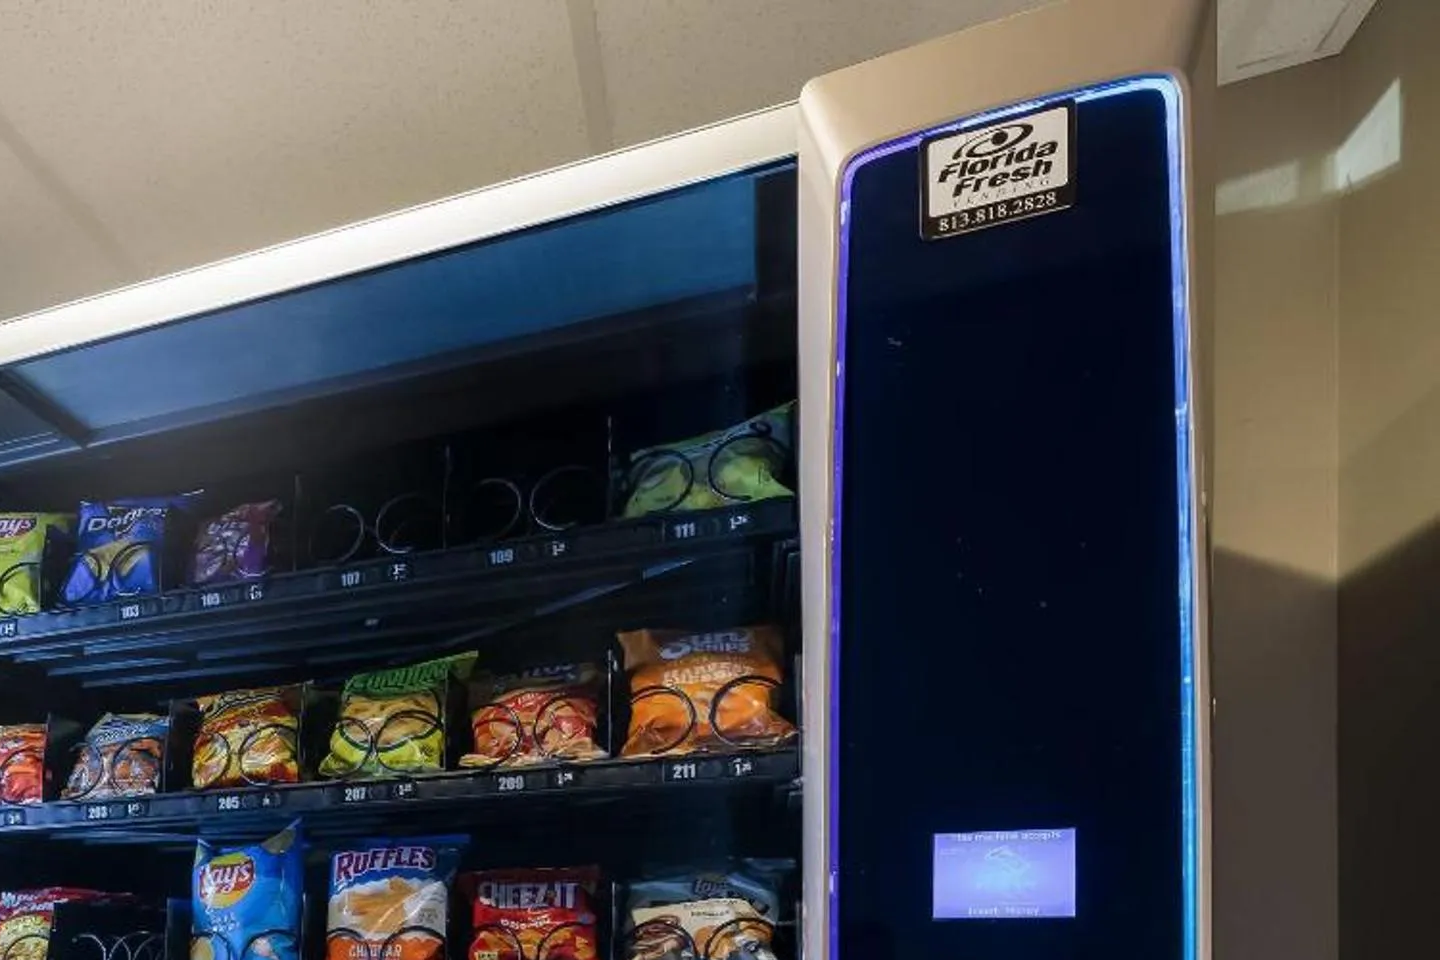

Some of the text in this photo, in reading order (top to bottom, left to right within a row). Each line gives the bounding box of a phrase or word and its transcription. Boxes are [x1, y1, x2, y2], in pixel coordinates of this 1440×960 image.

[938, 141, 1058, 183] Florida
[953, 159, 1053, 198] Fresh
[938, 191, 1058, 232] 813.818.2828
[673, 763, 696, 779] 211
[334, 848, 436, 883] RUFFLES
